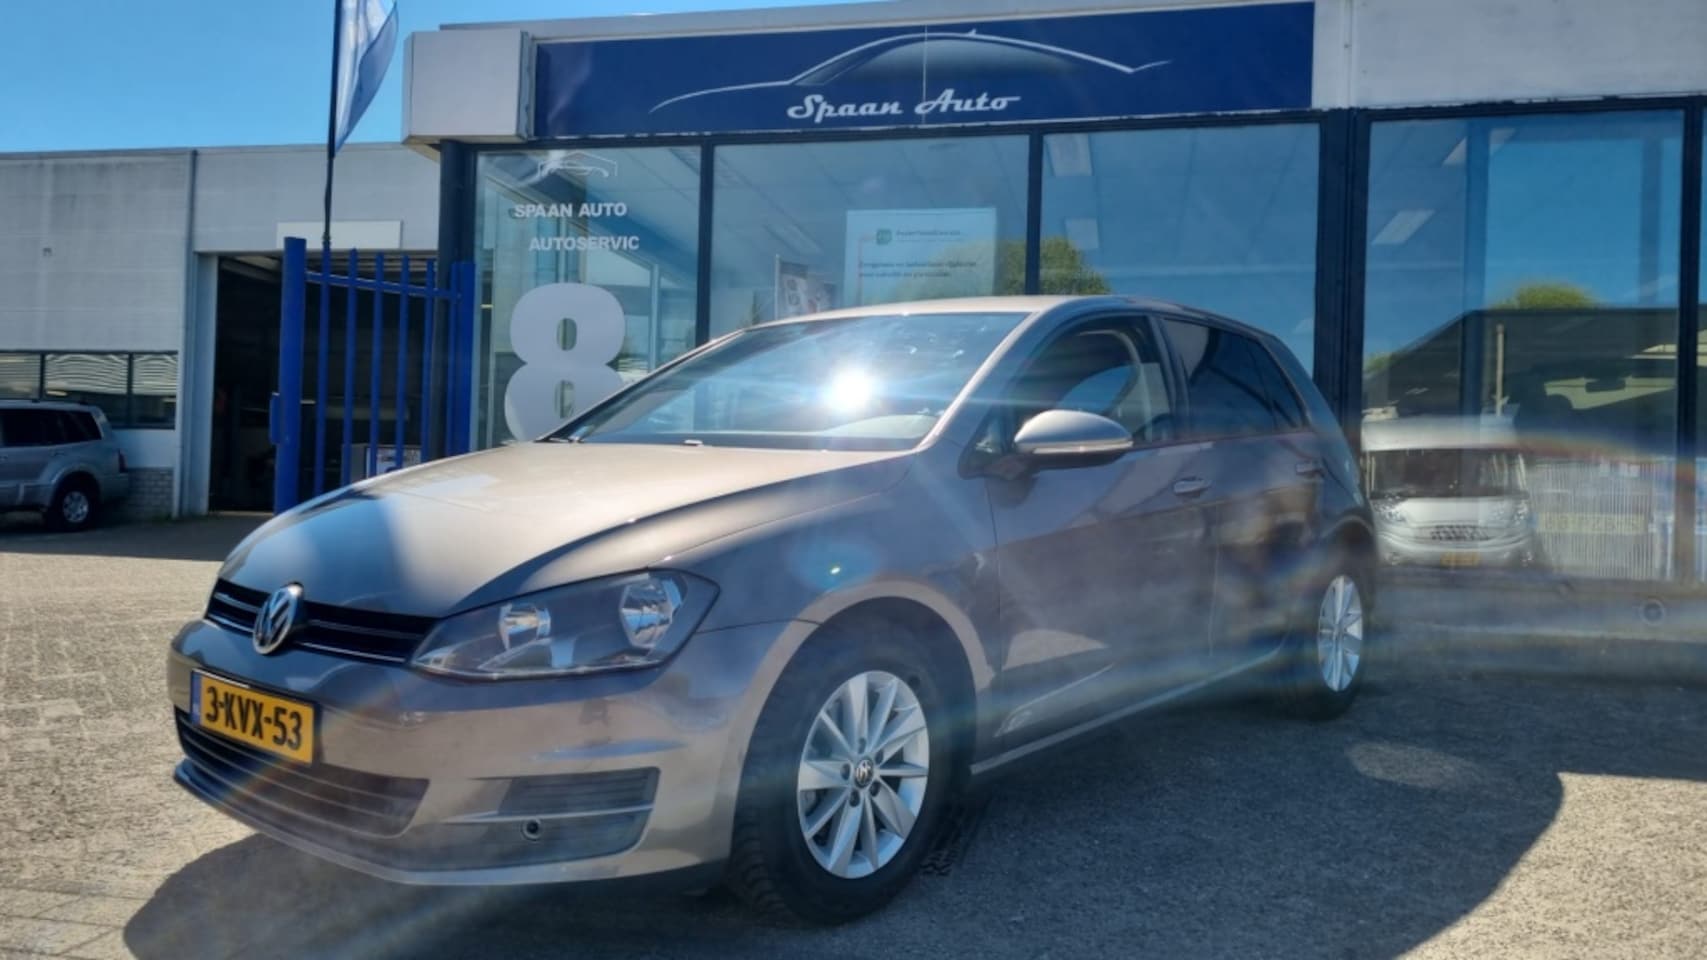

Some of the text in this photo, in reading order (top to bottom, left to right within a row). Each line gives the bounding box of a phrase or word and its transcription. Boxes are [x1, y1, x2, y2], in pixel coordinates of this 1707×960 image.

[786, 88, 1022, 124] Spaan Auto
[513, 202, 628, 218] SPAAN AUTO
[528, 235, 641, 251] AUTOSERVIC
[504, 282, 626, 442] 8
[205, 686, 302, 750] 3-KVX-53
